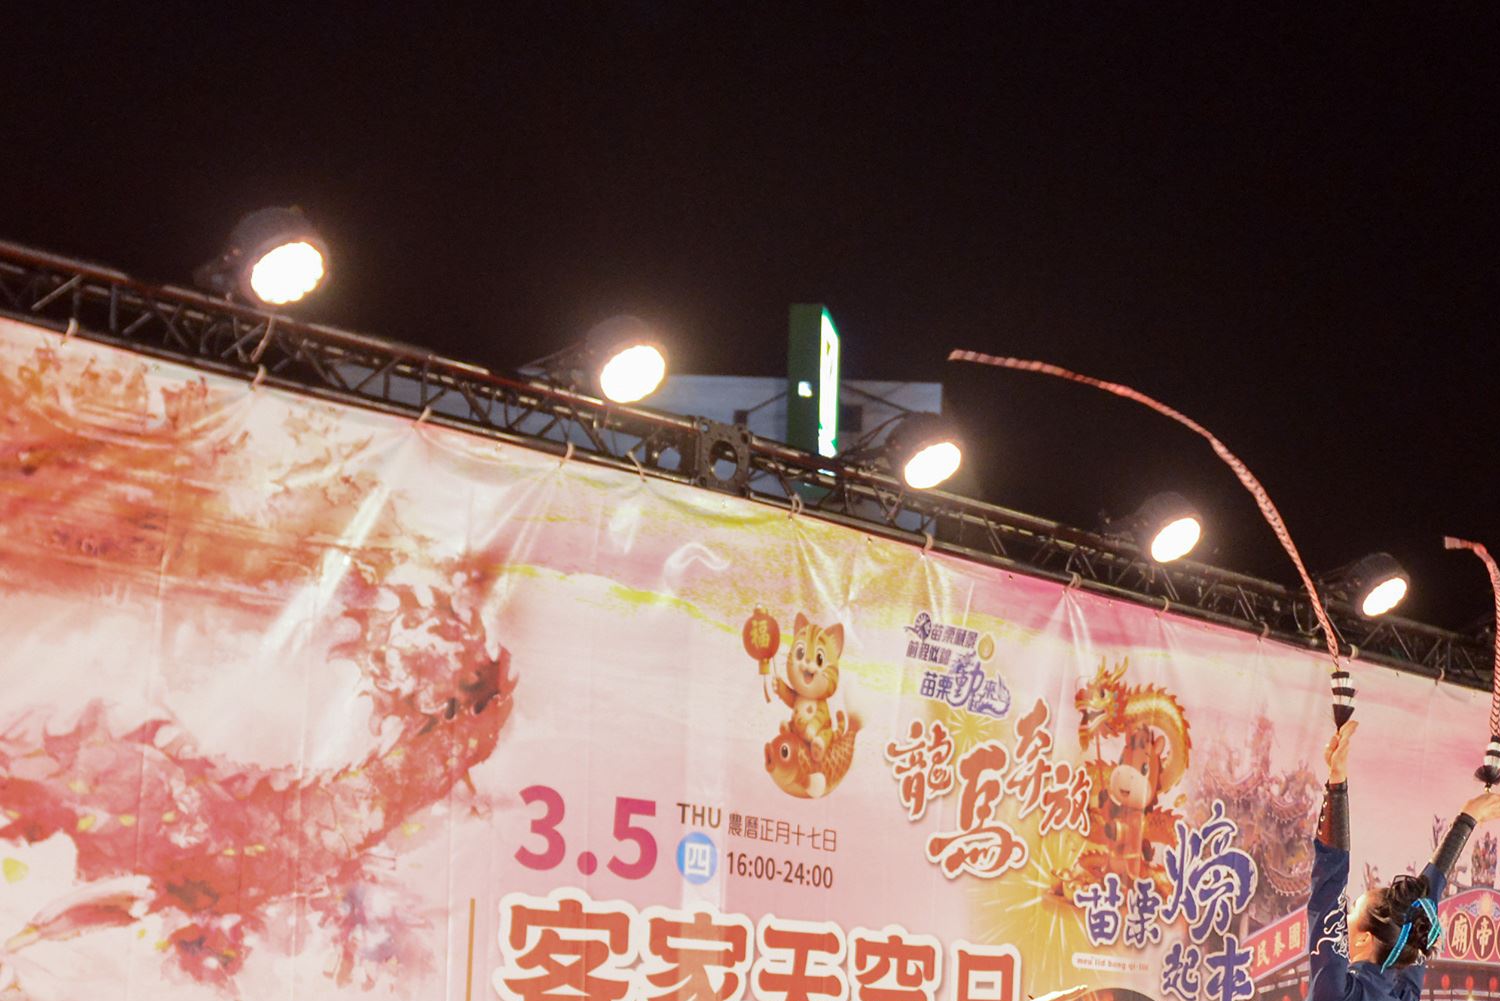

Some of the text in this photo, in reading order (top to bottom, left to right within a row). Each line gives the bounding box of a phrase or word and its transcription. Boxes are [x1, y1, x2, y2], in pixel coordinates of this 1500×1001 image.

[751, 620, 771, 648] 福
[887, 698, 1090, 872] 龍馬奔放
[514, 785, 657, 880] 3.5
[676, 802, 722, 829] THU
[727, 813, 837, 852] 農曆正月十七日
[684, 841, 711, 876] 四
[726, 852, 833, 888] 16:00-24:00
